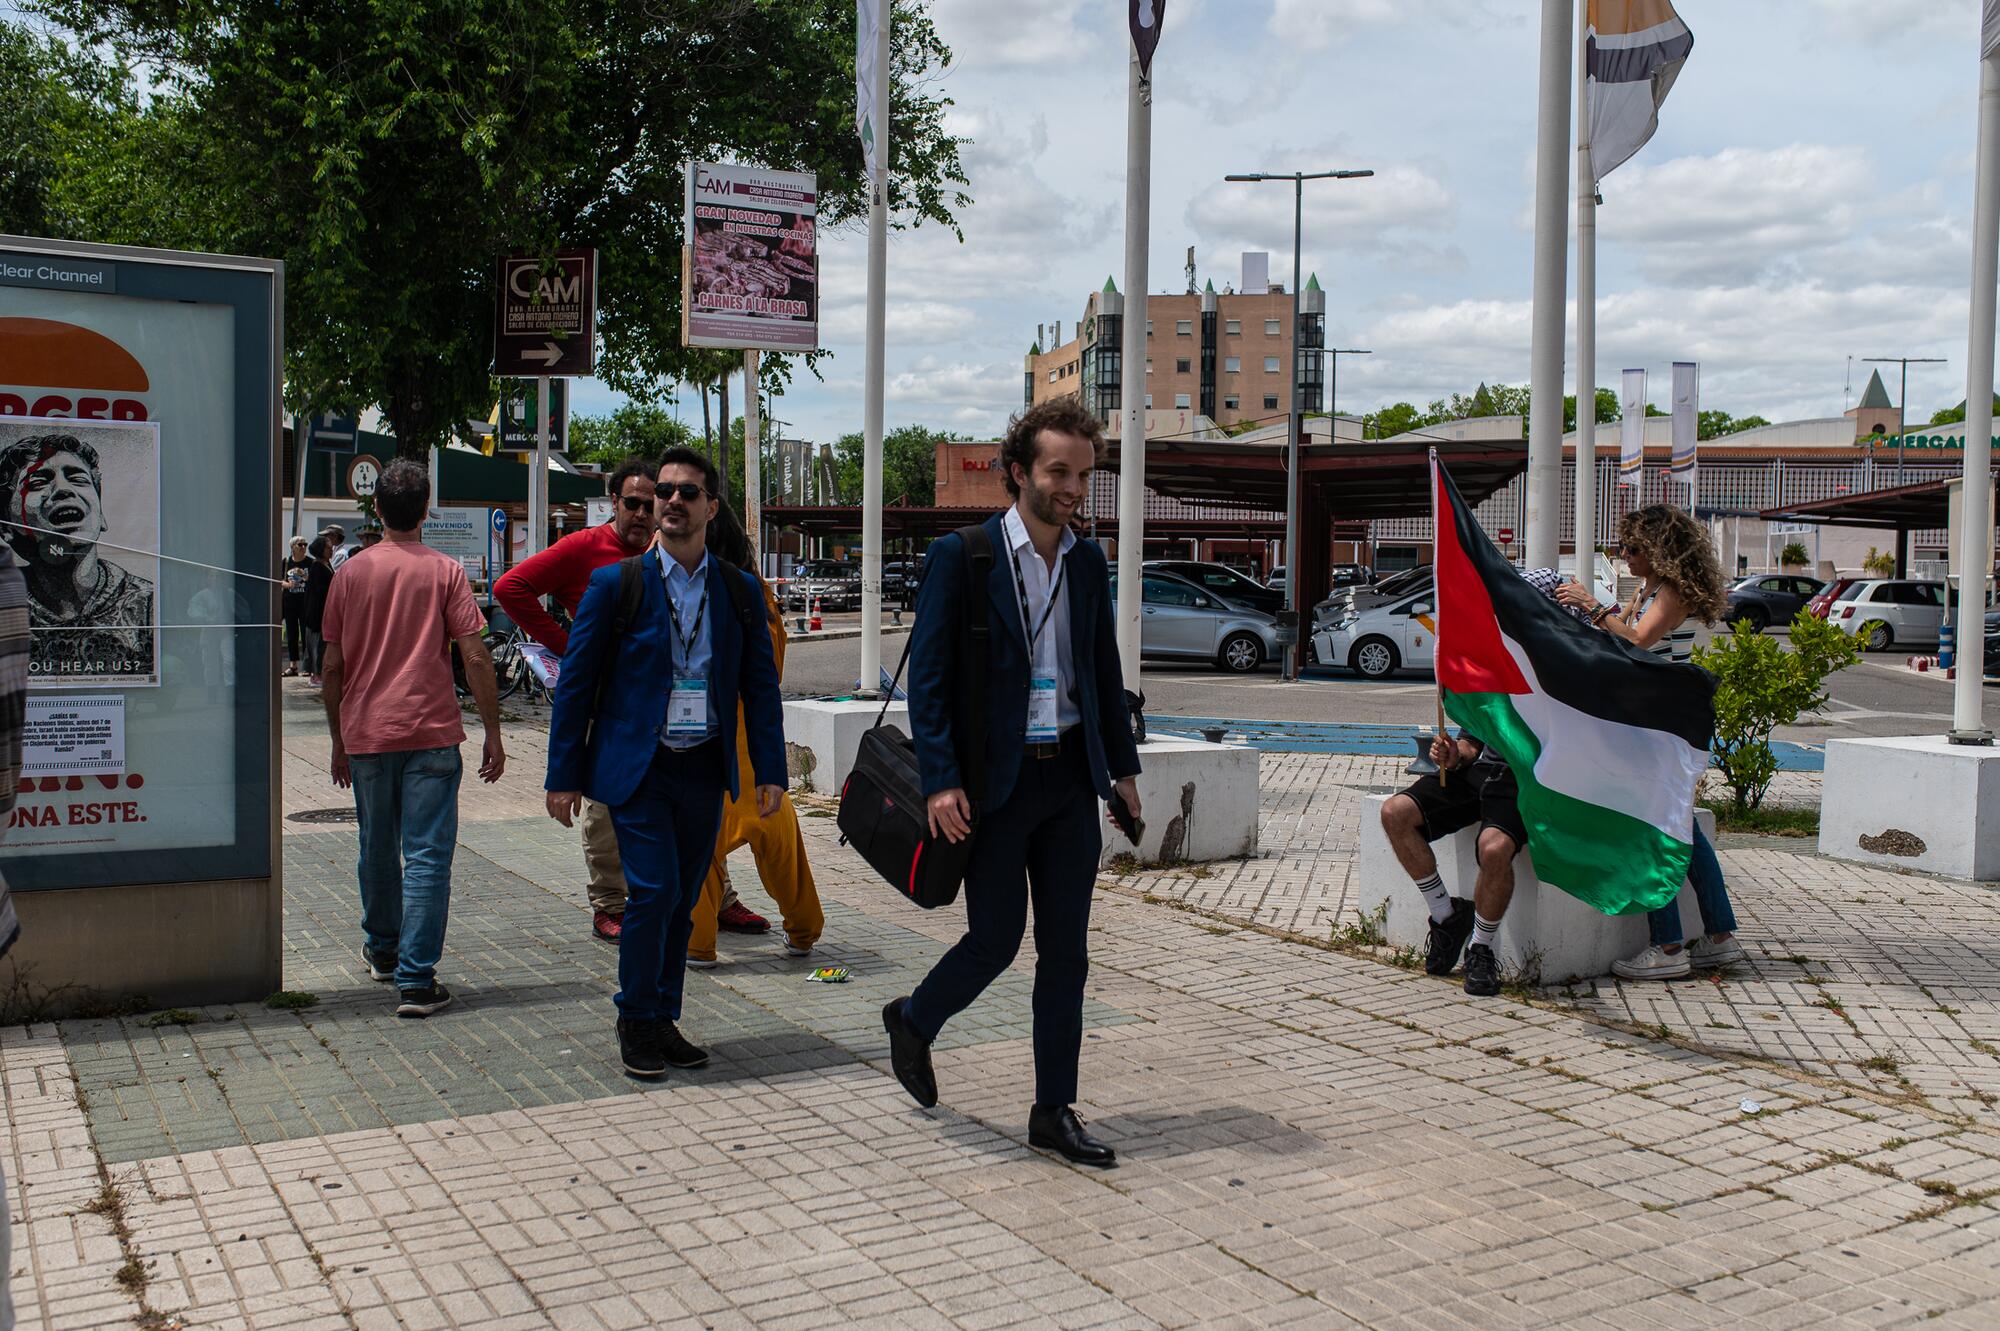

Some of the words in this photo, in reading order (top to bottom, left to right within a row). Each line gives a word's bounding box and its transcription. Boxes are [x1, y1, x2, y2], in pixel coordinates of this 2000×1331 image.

[749, 187, 762, 195] CASA
[695, 205, 726, 220] GRAN
[728, 210, 782, 227] NOVEDAD
[724, 222, 736, 232] EN
[736, 224, 778, 238] NUESTRAS
[778, 228, 814, 242] COCINAS
[0, 263, 34, 278] lear
[37, 266, 103, 284] Channel
[510, 264, 580, 304] CAM
[699, 292, 744, 310] CARNES
[744, 297, 754, 311] A
[755, 298, 770, 313] LA
[770, 300, 808, 316] BRASA
[508, 312, 525, 322] CASA
[526, 312, 552, 321] ANTONIO
[552, 312, 579, 320] MORENO
[28, 662, 52, 672] OU
[60, 661, 105, 672] HEAR
[112, 660, 141, 671] US?
[8, 805, 61, 828] NA
[68, 802, 147, 826] ESTE.
